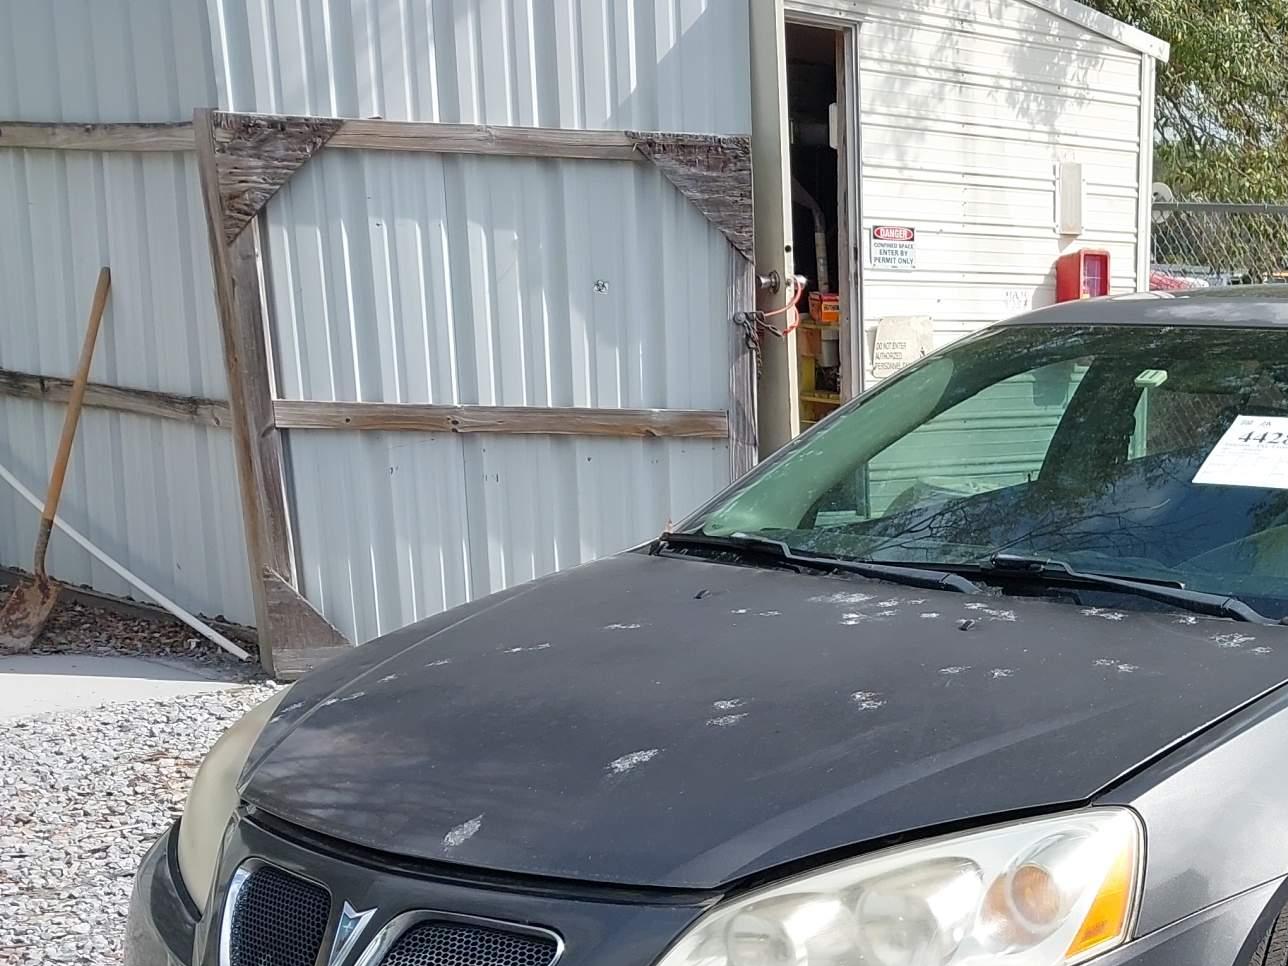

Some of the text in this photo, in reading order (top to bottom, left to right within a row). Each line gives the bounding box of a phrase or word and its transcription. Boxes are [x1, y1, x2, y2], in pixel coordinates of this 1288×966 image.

[879, 227, 907, 239] DANGER
[873, 256, 913, 265] PERMIT ONLY
